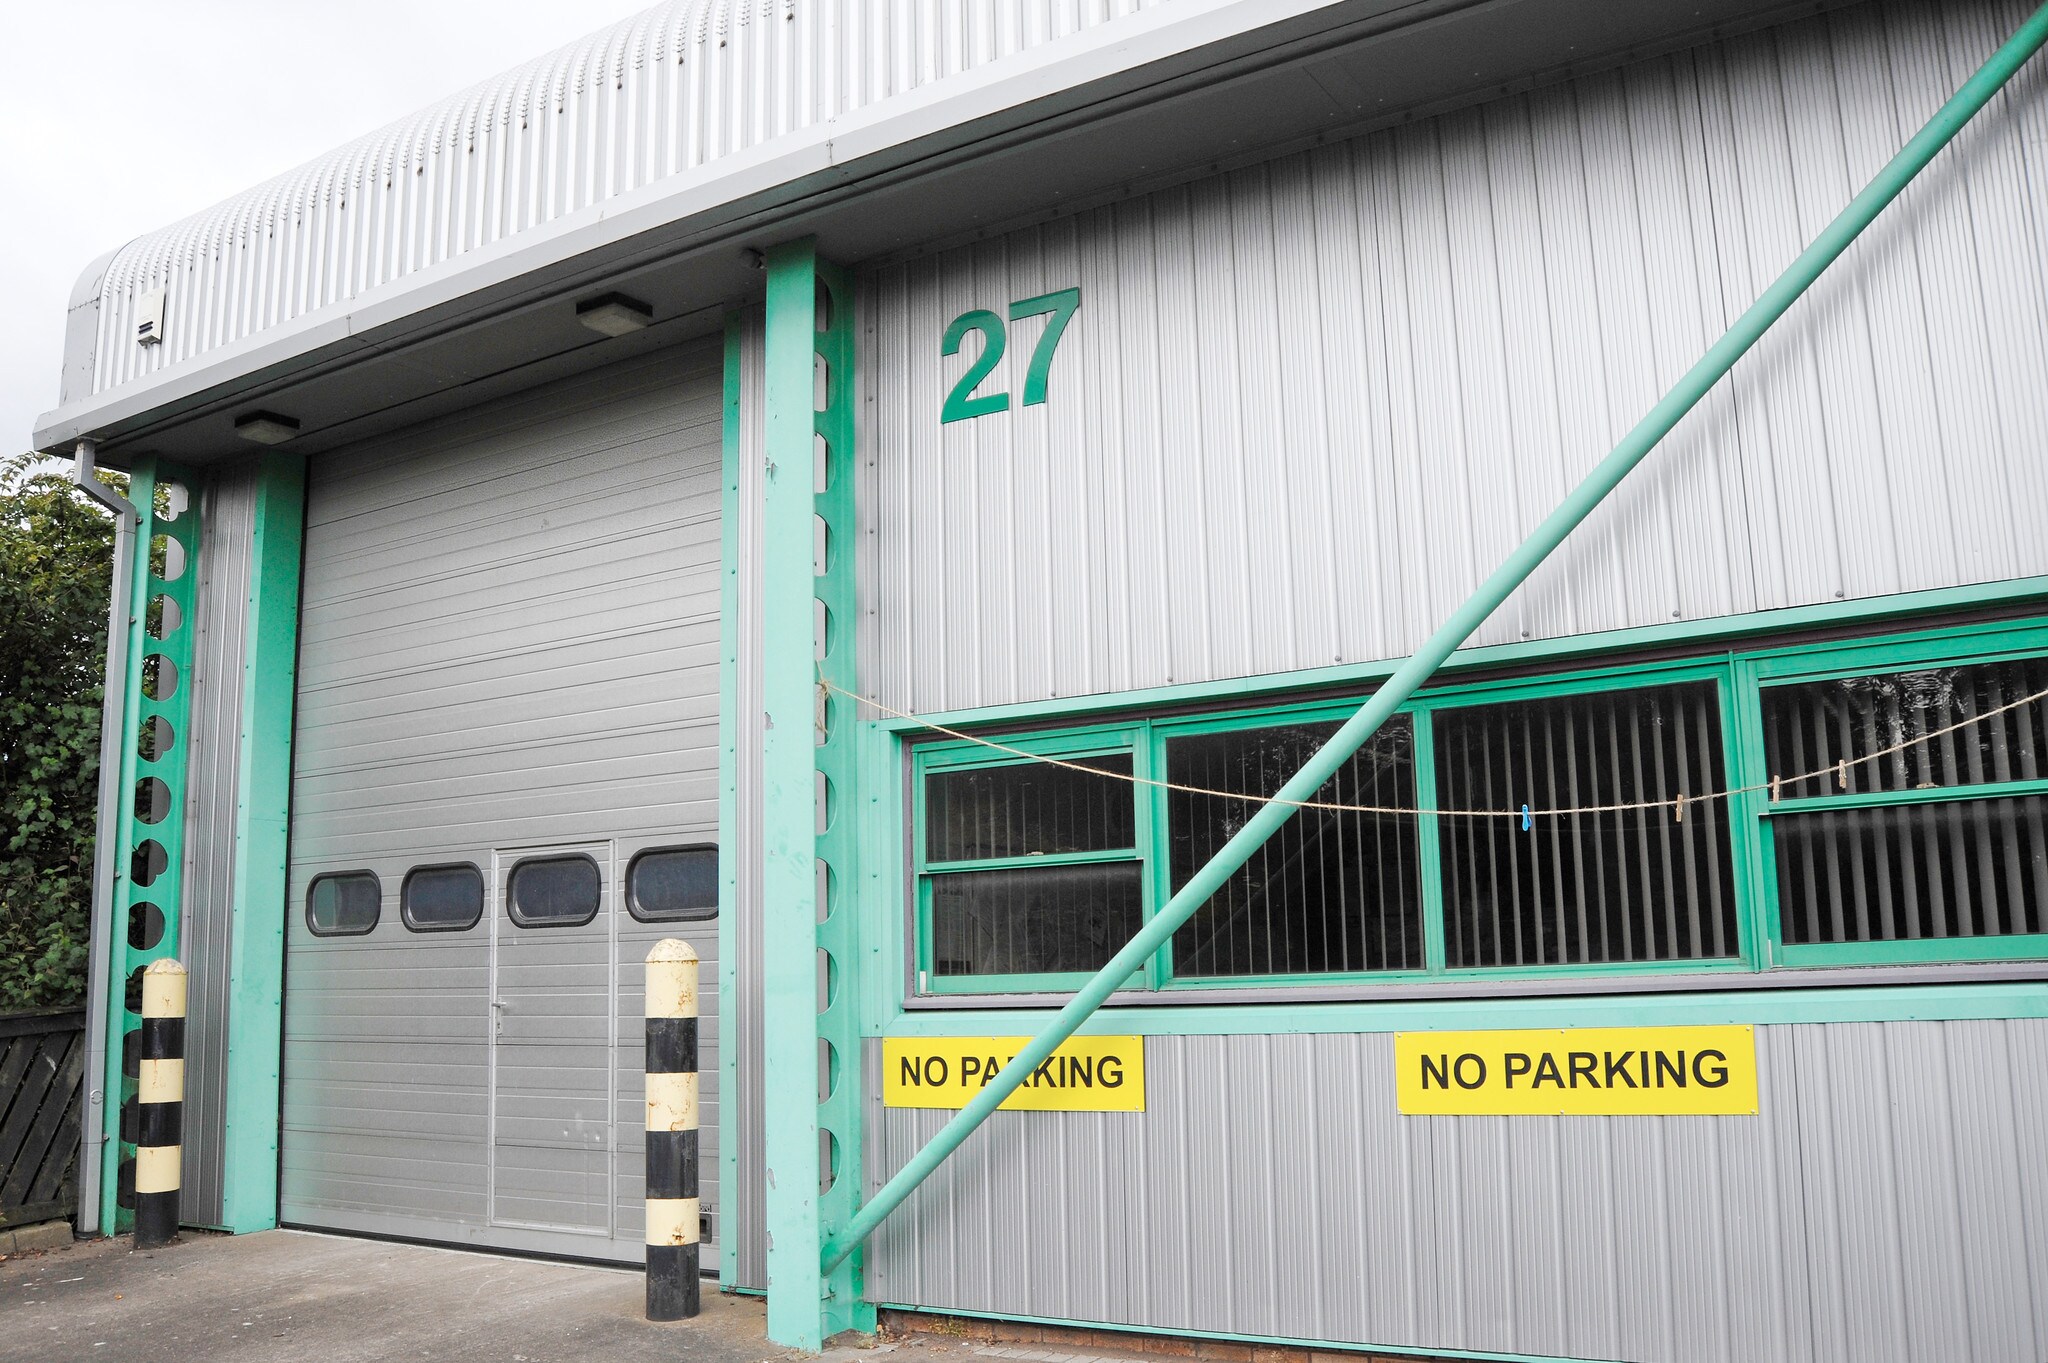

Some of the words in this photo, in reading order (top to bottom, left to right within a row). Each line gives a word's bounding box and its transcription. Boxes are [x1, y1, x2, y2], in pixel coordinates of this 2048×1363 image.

[941, 287, 1080, 425] 27
[901, 1055, 949, 1087] NO
[961, 1055, 1124, 1088] PAKING
[1421, 1053, 1487, 1090] NO
[1504, 1049, 1729, 1089] PARKING
